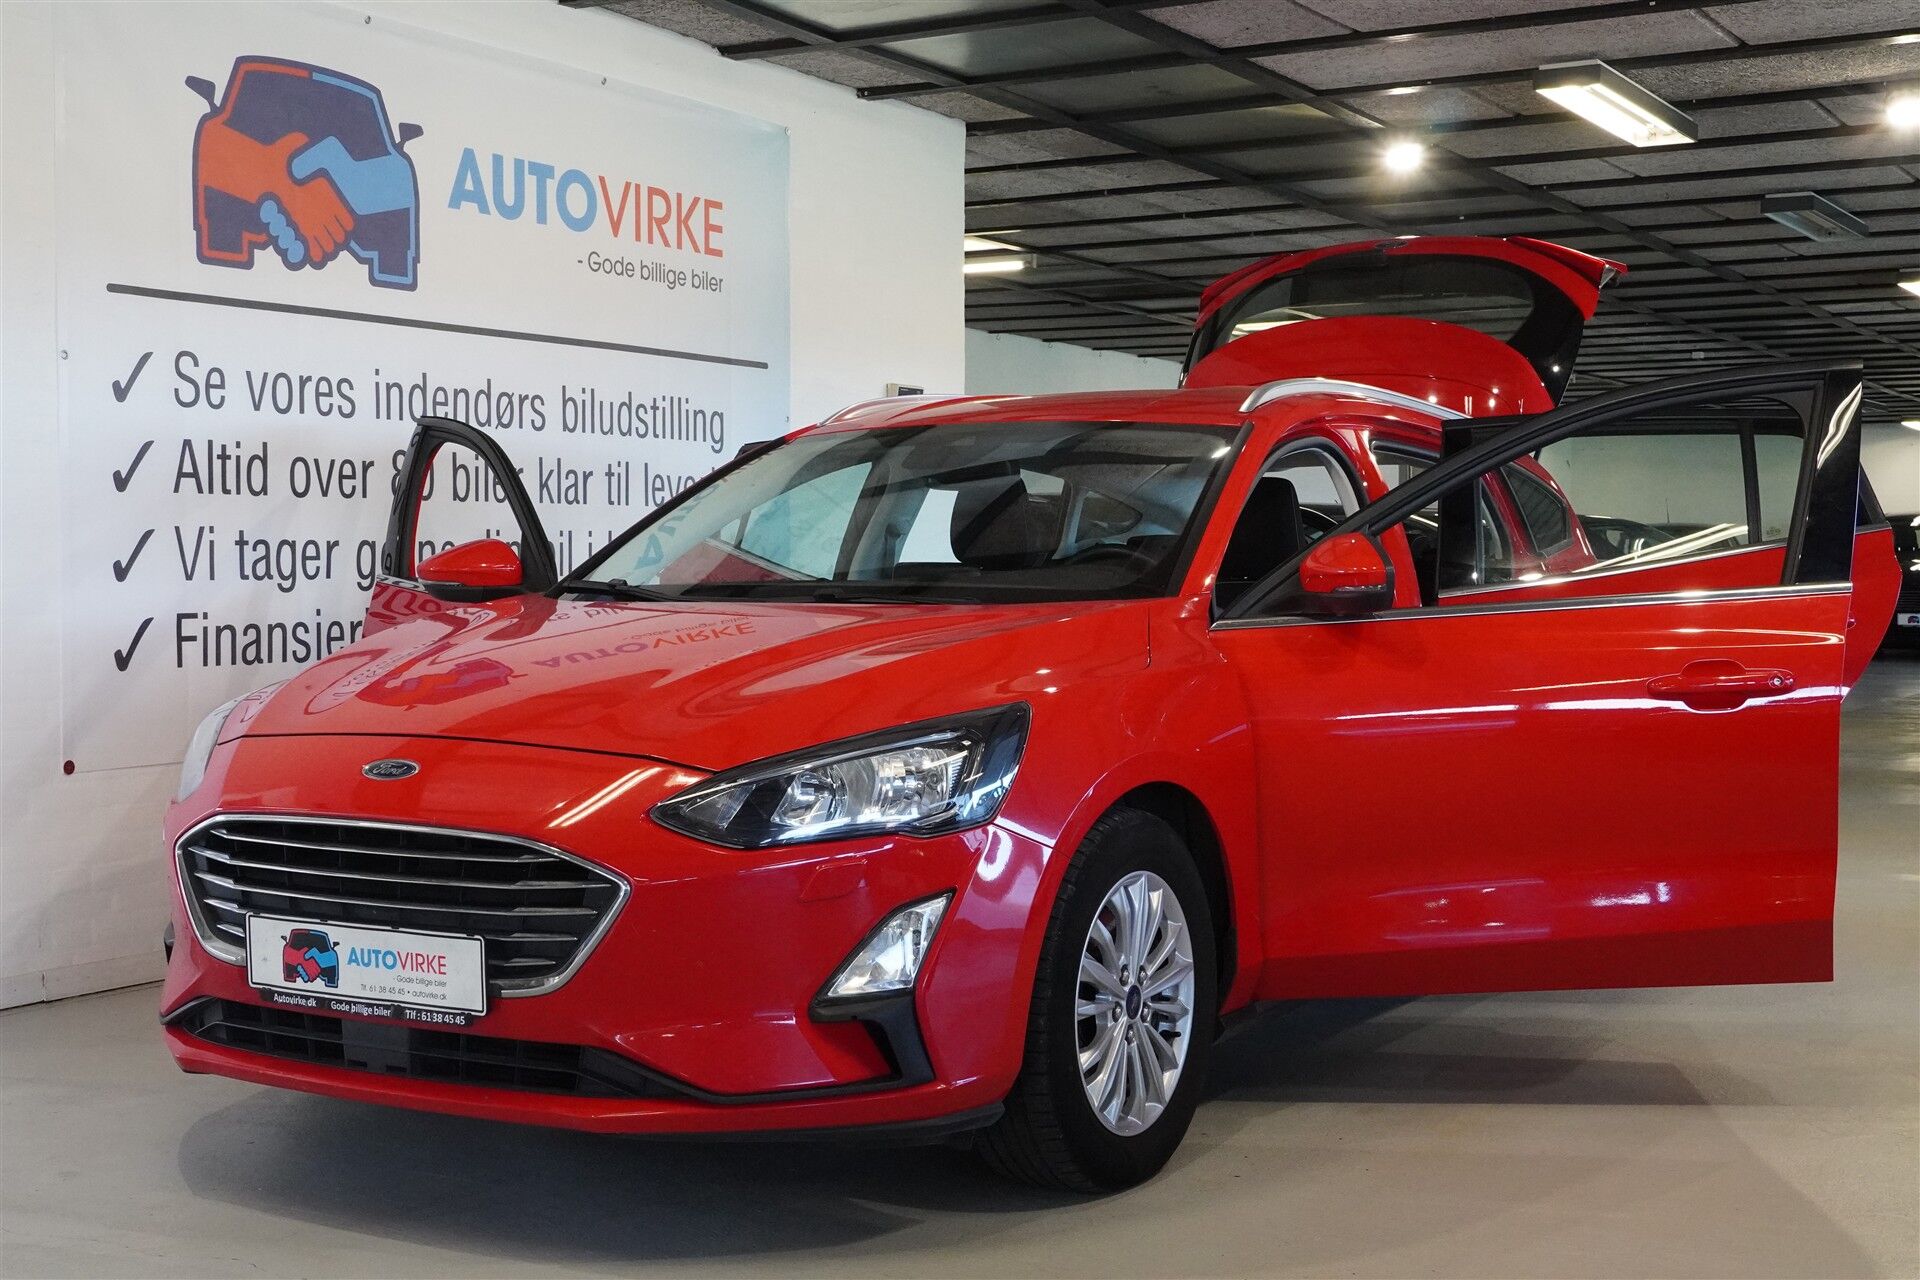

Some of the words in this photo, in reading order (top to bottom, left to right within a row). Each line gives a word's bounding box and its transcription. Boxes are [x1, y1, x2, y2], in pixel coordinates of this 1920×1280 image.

[447, 147, 724, 258] AUTOVIRKE
[587, 251, 636, 278] Gode
[640, 260, 687, 290] billige
[691, 269, 724, 293] biler
[173, 350, 227, 410] Se
[245, 370, 357, 419] vores
[374, 368, 547, 432] indendørs
[561, 385, 725, 454] biludstilling
[173, 438, 269, 497] Altid
[289, 455, 375, 499] over
[538, 456, 594, 506] klar
[605, 461, 630, 507] til
[174, 525, 215, 581] Vi
[234, 529, 340, 593] tager
[372, 762, 408, 776] Ford
[347, 947, 447, 975] AUTOVIRKE
[368, 984, 377, 992] 61
[378, 985, 387, 994] 38
[388, 986, 396, 995] 45
[397, 988, 406, 996] 45
[396, 975, 414, 984] Gode
[415, 977, 433, 988] billige
[434, 979, 447, 988] biler
[330, 1001, 350, 1012] Gode
[350, 1003, 373, 1016] billige
[373, 1007, 391, 1017] biler
